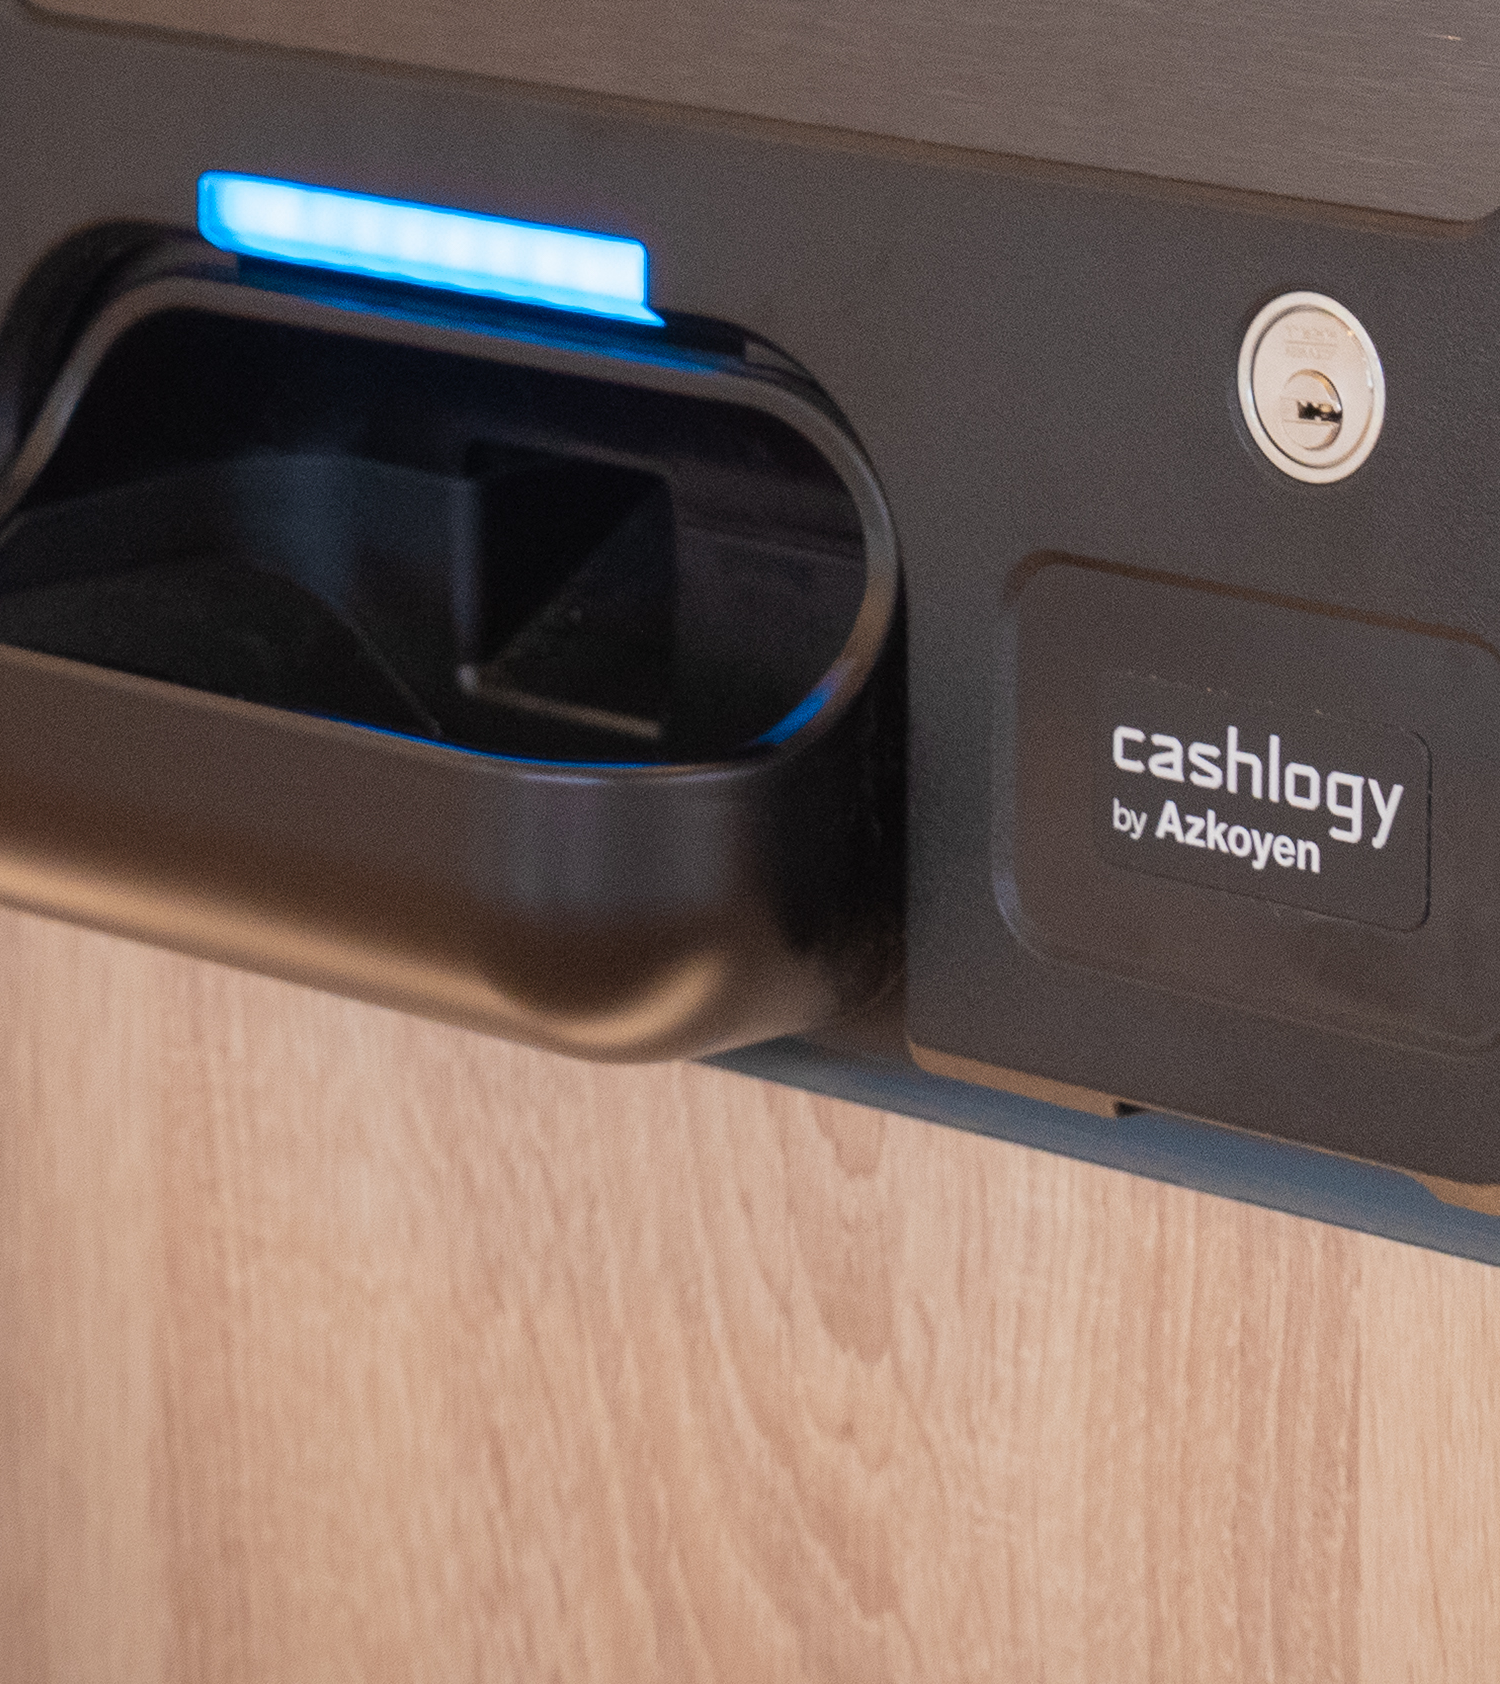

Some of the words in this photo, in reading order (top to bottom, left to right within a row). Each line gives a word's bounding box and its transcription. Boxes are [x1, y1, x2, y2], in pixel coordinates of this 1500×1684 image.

[1112, 797, 1147, 840] by
[1155, 800, 1320, 873] Azkoyen
[1113, 725, 1403, 849] cashlogy
